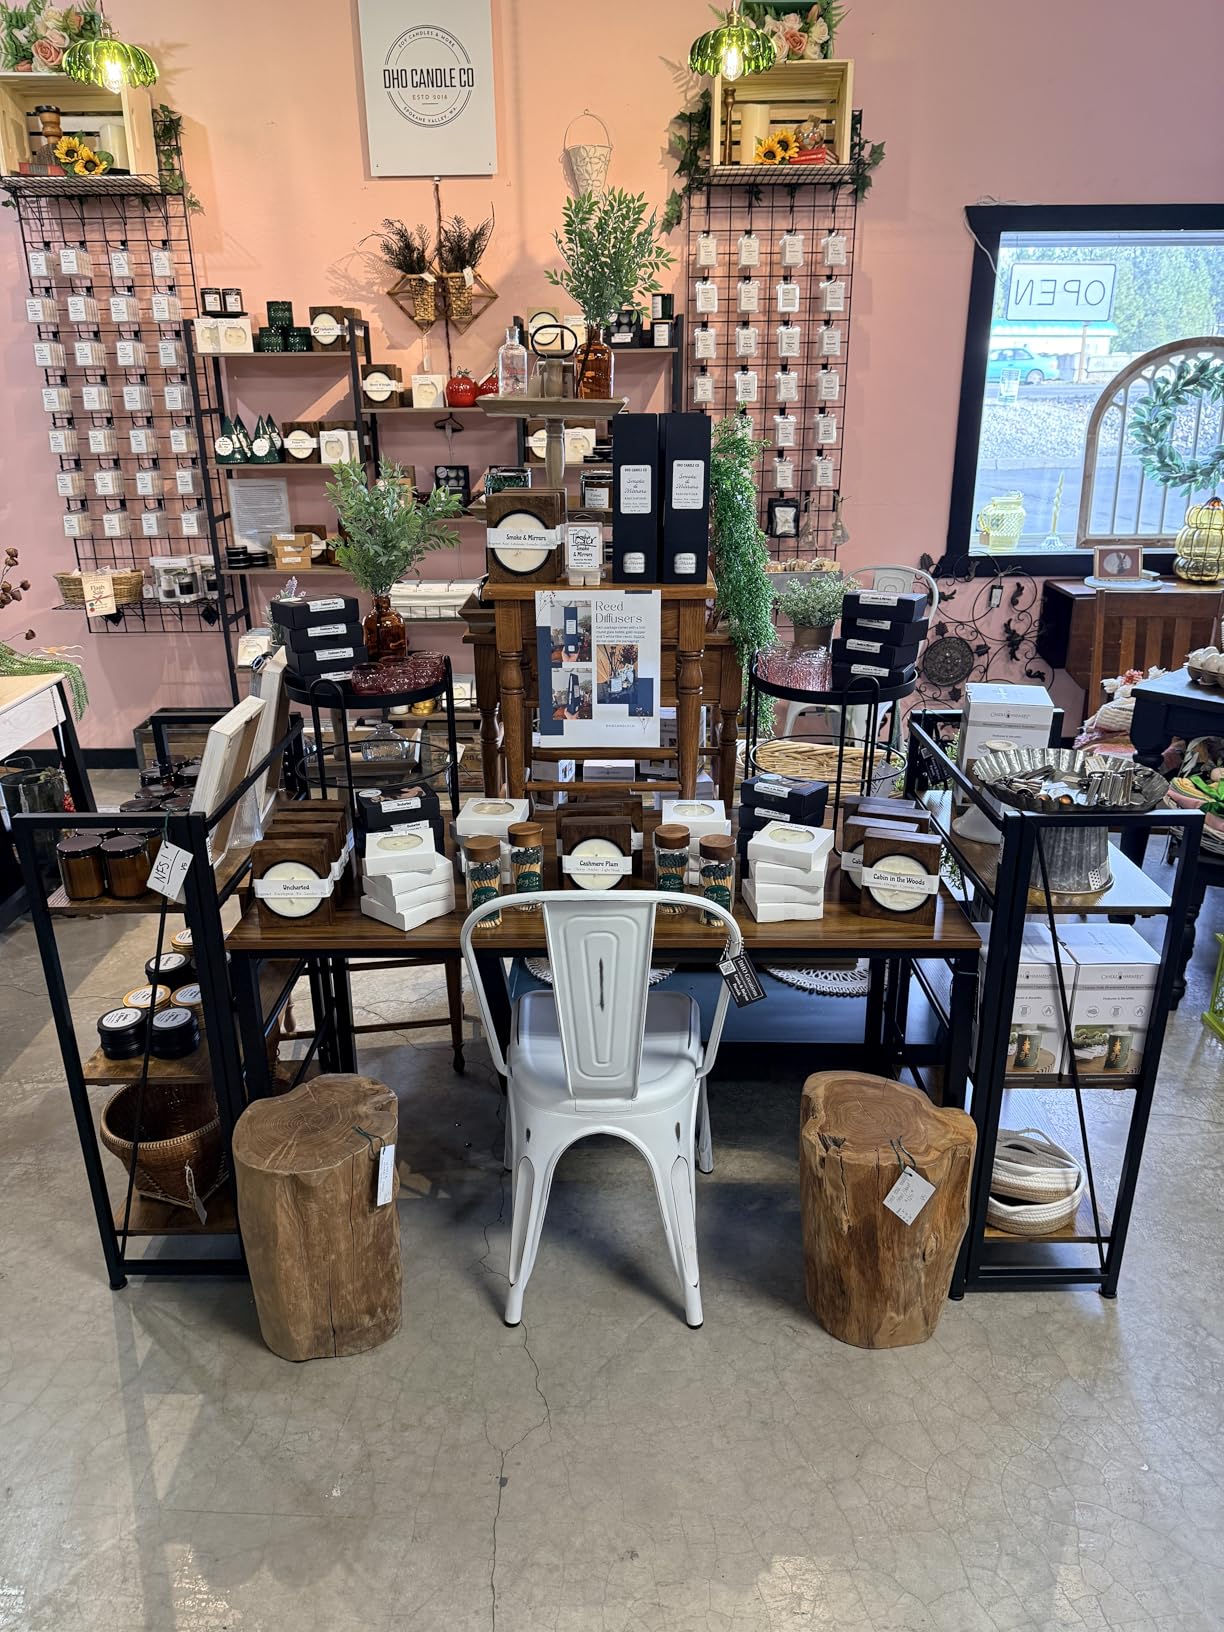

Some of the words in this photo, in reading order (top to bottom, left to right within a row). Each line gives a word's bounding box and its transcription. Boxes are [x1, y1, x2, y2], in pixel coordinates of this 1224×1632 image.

[409, 30, 433, 39] CANDLES
[441, 35, 455, 47] MORE
[383, 68, 408, 88] DHO
[411, 68, 456, 88] CANDLE
[459, 68, 474, 87] CO
[403, 106, 425, 122] SPOKANE
[596, 601, 623, 611] Reed
[596, 613, 642, 623] Diffusers
